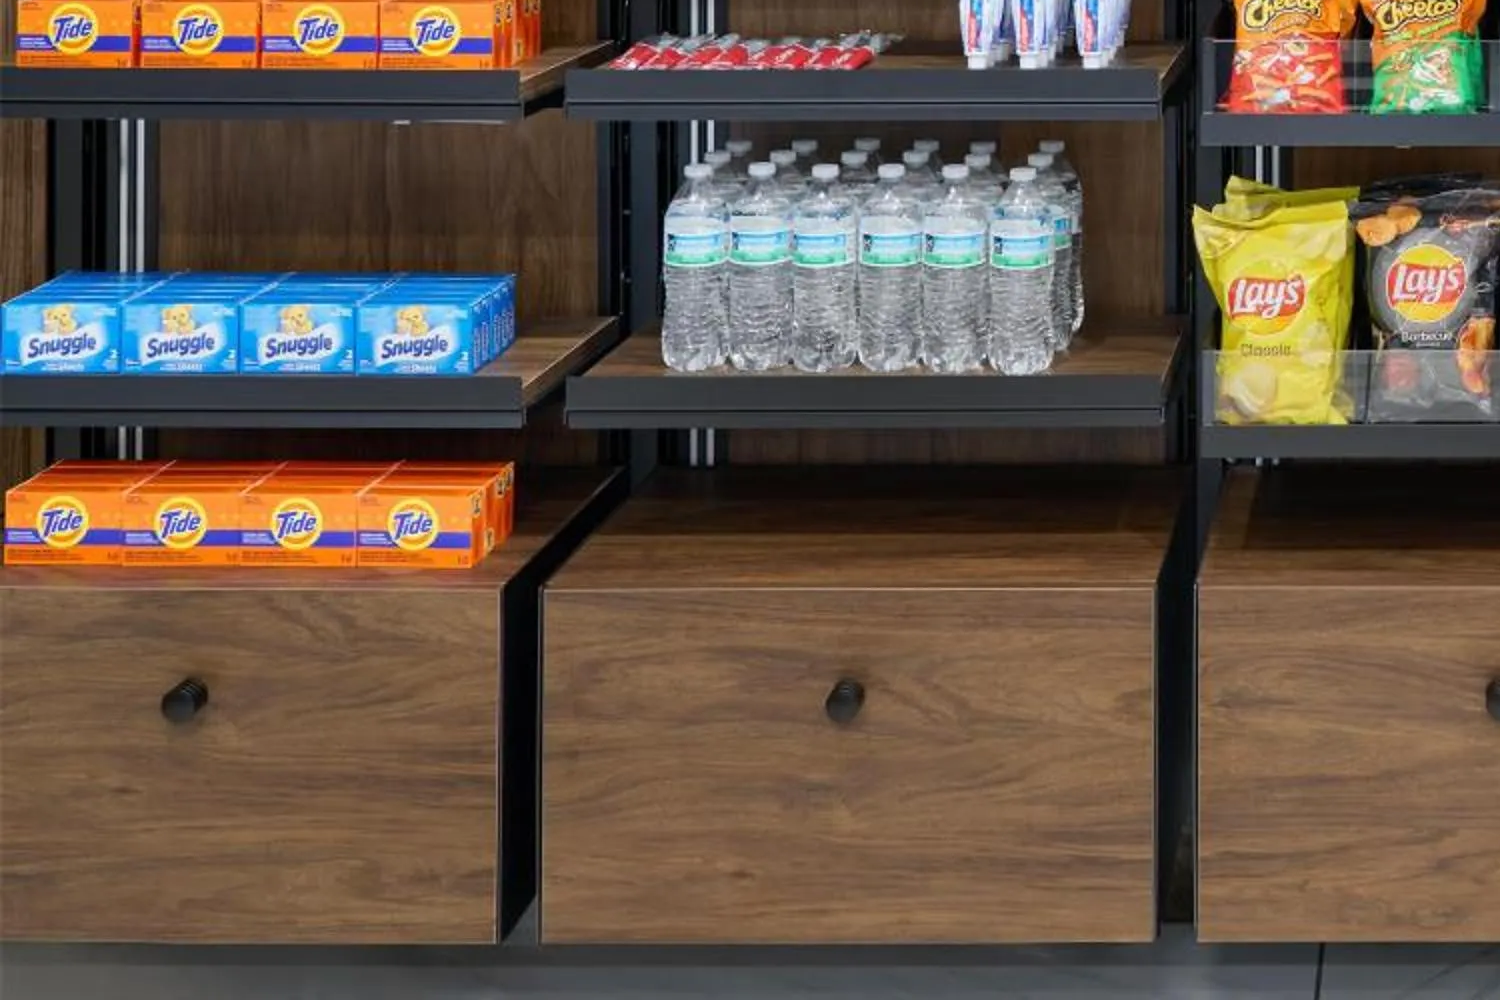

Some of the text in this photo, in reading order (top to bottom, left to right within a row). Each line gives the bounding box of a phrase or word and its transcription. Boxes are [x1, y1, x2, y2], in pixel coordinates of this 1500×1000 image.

[54, 15, 93, 42] Tide
[178, 17, 218, 44] Tide
[300, 17, 338, 44] Tide
[416, 19, 454, 46] Tide
[1394, 262, 1462, 303] Lay's
[1234, 276, 1302, 318] Lay's
[28, 332, 96, 358] Snuggle
[147, 332, 215, 358] Snuggle
[265, 333, 333, 358] Snuggle
[381, 334, 448, 359] Snuggle
[42, 508, 83, 537] Tide
[160, 510, 201, 539] Tide
[277, 510, 317, 538] Tide
[393, 511, 432, 540] Tide
